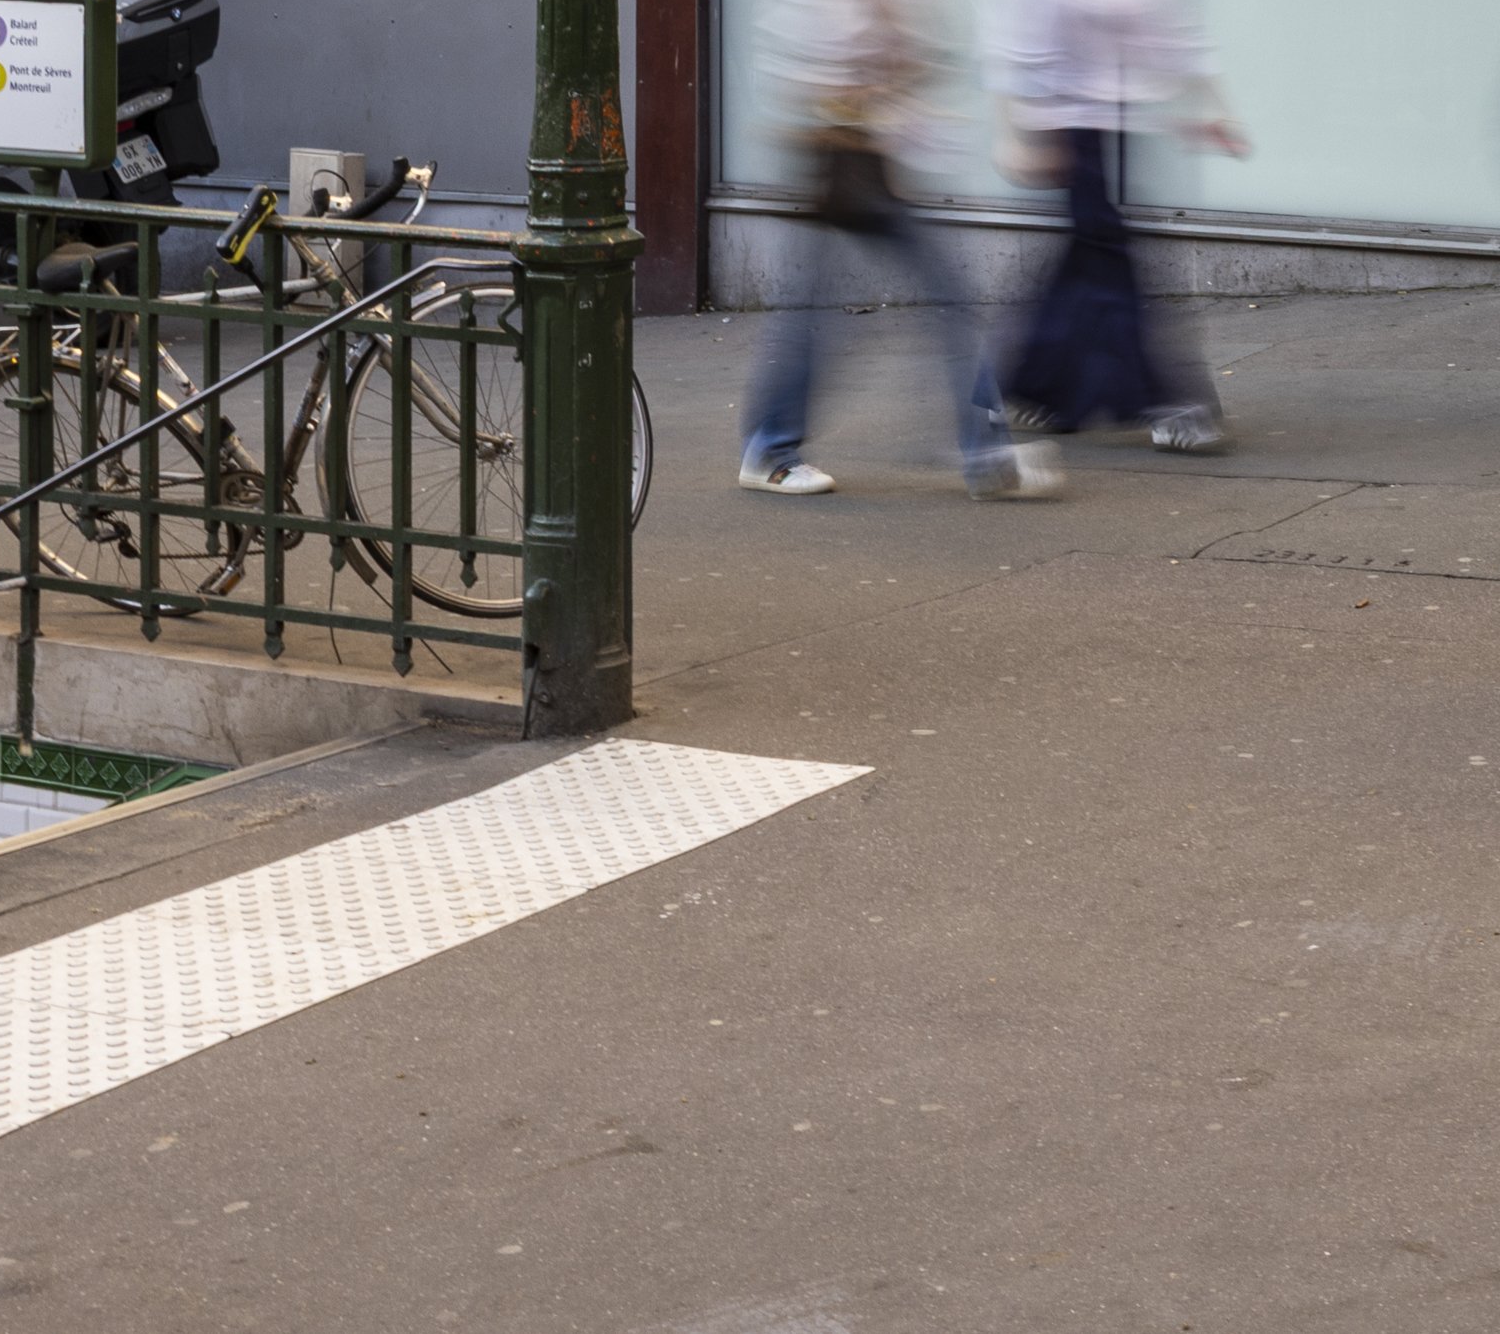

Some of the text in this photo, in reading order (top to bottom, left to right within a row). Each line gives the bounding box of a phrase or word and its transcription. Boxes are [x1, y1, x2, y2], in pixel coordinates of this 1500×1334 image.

[10, 19, 38, 30] Balard
[9, 35, 39, 47] Créteil
[9, 64, 72, 79] Pont de Sèvres
[9, 81, 52, 93] Montreuil
